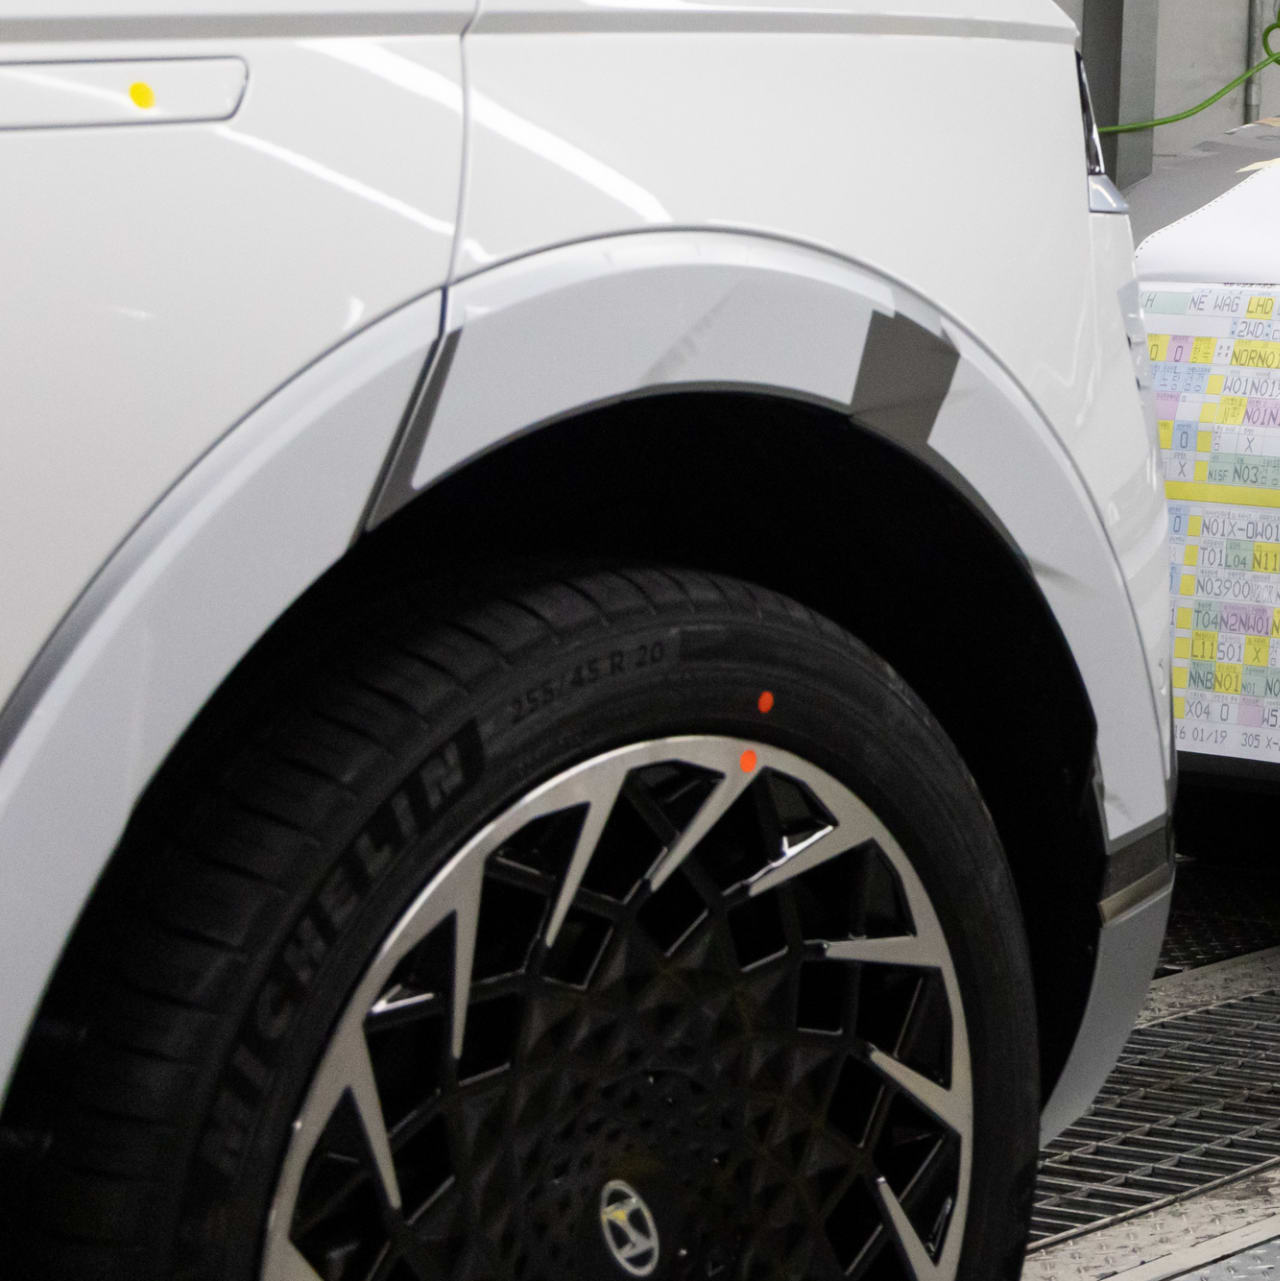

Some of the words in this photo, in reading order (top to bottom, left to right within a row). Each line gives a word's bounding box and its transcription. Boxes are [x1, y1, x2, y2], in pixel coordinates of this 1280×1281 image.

[1189, 294, 1208, 311] NE
[1213, 295, 1241, 313] WAG
[1246, 297, 1274, 315] LHD
[1236, 321, 1265, 338] 2WD
[1245, 437, 1256, 453] X
[1177, 461, 1187, 478] X
[1232, 465, 1260, 484] N03
[1200, 547, 1224, 568] T01
[1252, 552, 1279, 572] N11
[1194, 610, 1219, 631] T04
[610, 649, 625, 674] R
[635, 641, 665, 668] 20
[1253, 647, 1261, 663] X
[1213, 673, 1239, 693] N01
[1192, 727, 1228, 744] 01/19
[1241, 732, 1260, 749] 305
[200, 738, 466, 1176] MICHELIN
